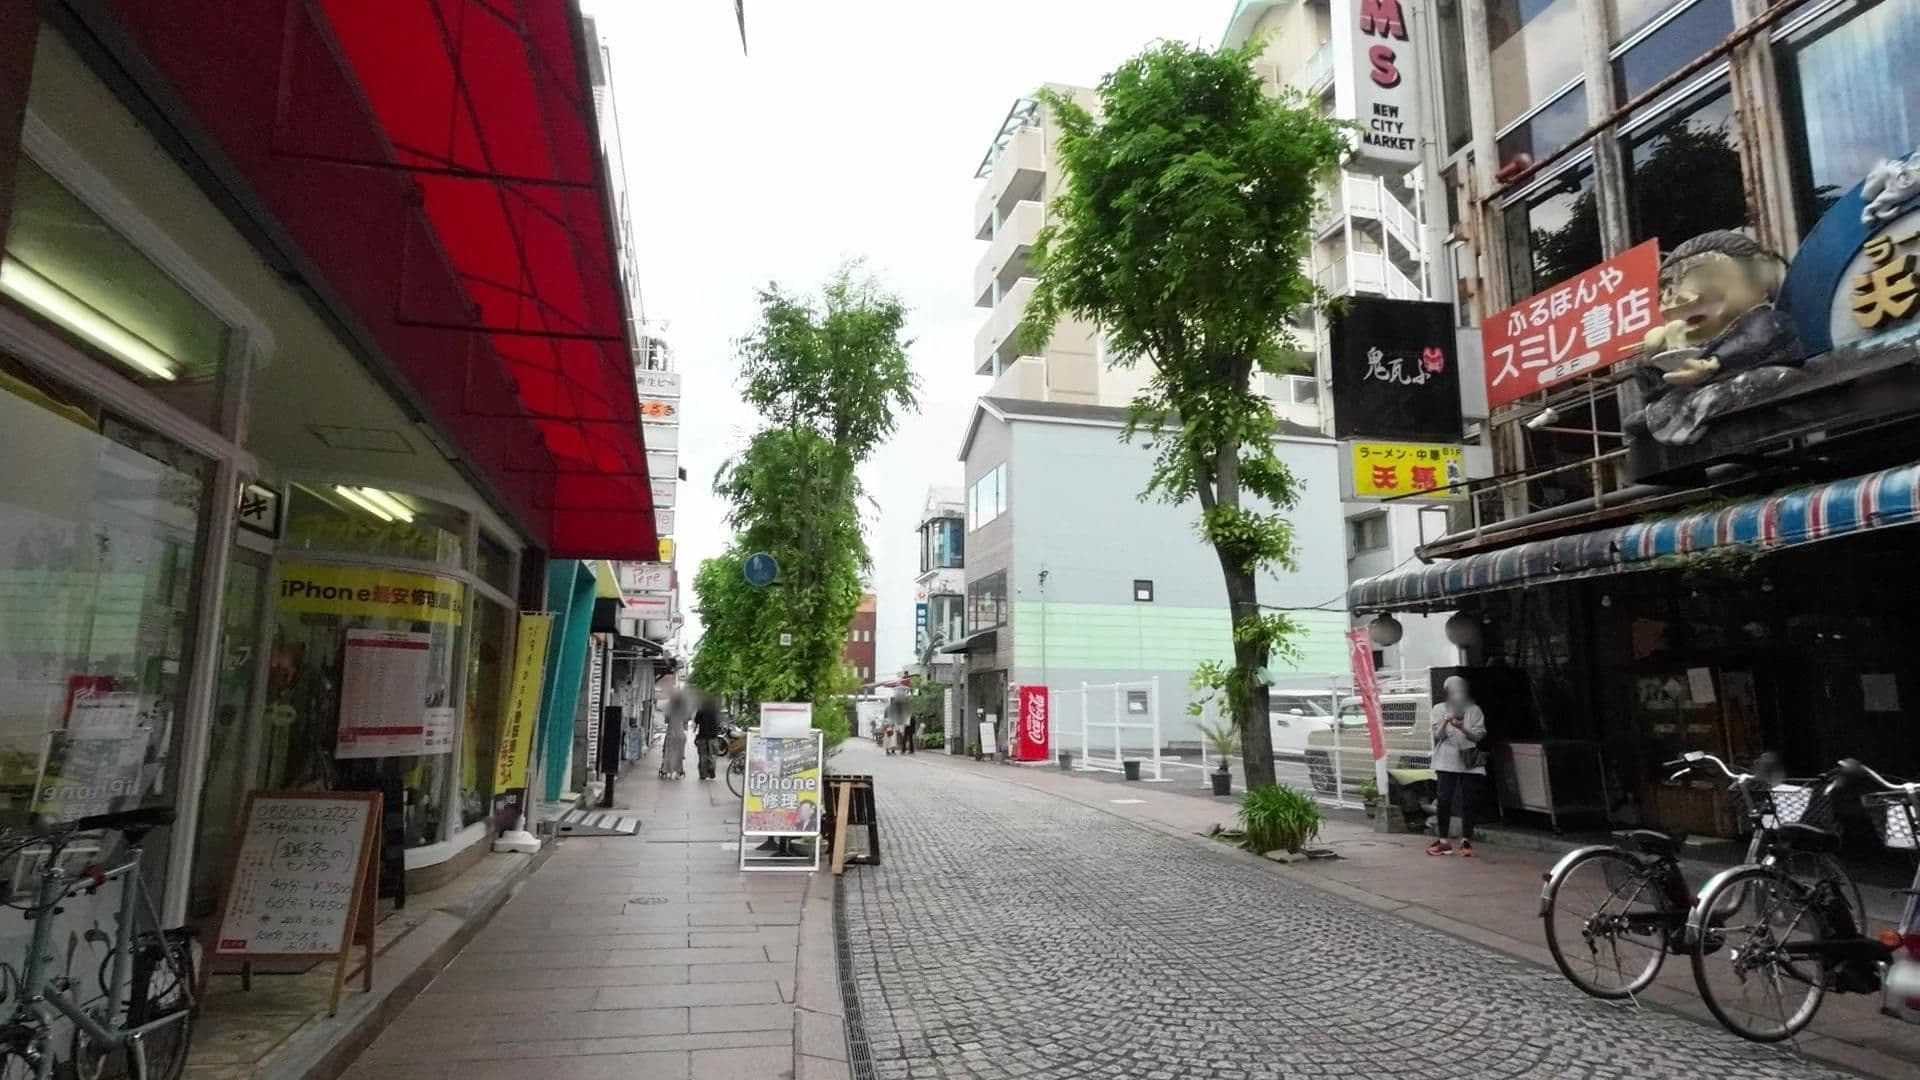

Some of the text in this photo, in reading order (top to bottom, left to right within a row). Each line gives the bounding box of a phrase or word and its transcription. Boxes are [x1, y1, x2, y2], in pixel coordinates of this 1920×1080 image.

[1373, 103, 1399, 118] NEW
[1371, 119, 1404, 134] CITY
[1363, 132, 1415, 150] MARKET
[1508, 266, 1624, 337] ふるほんや
[1492, 287, 1652, 386] スミレ書店
[750, 773, 817, 791] iPhone
[762, 793, 799, 810] 修理
